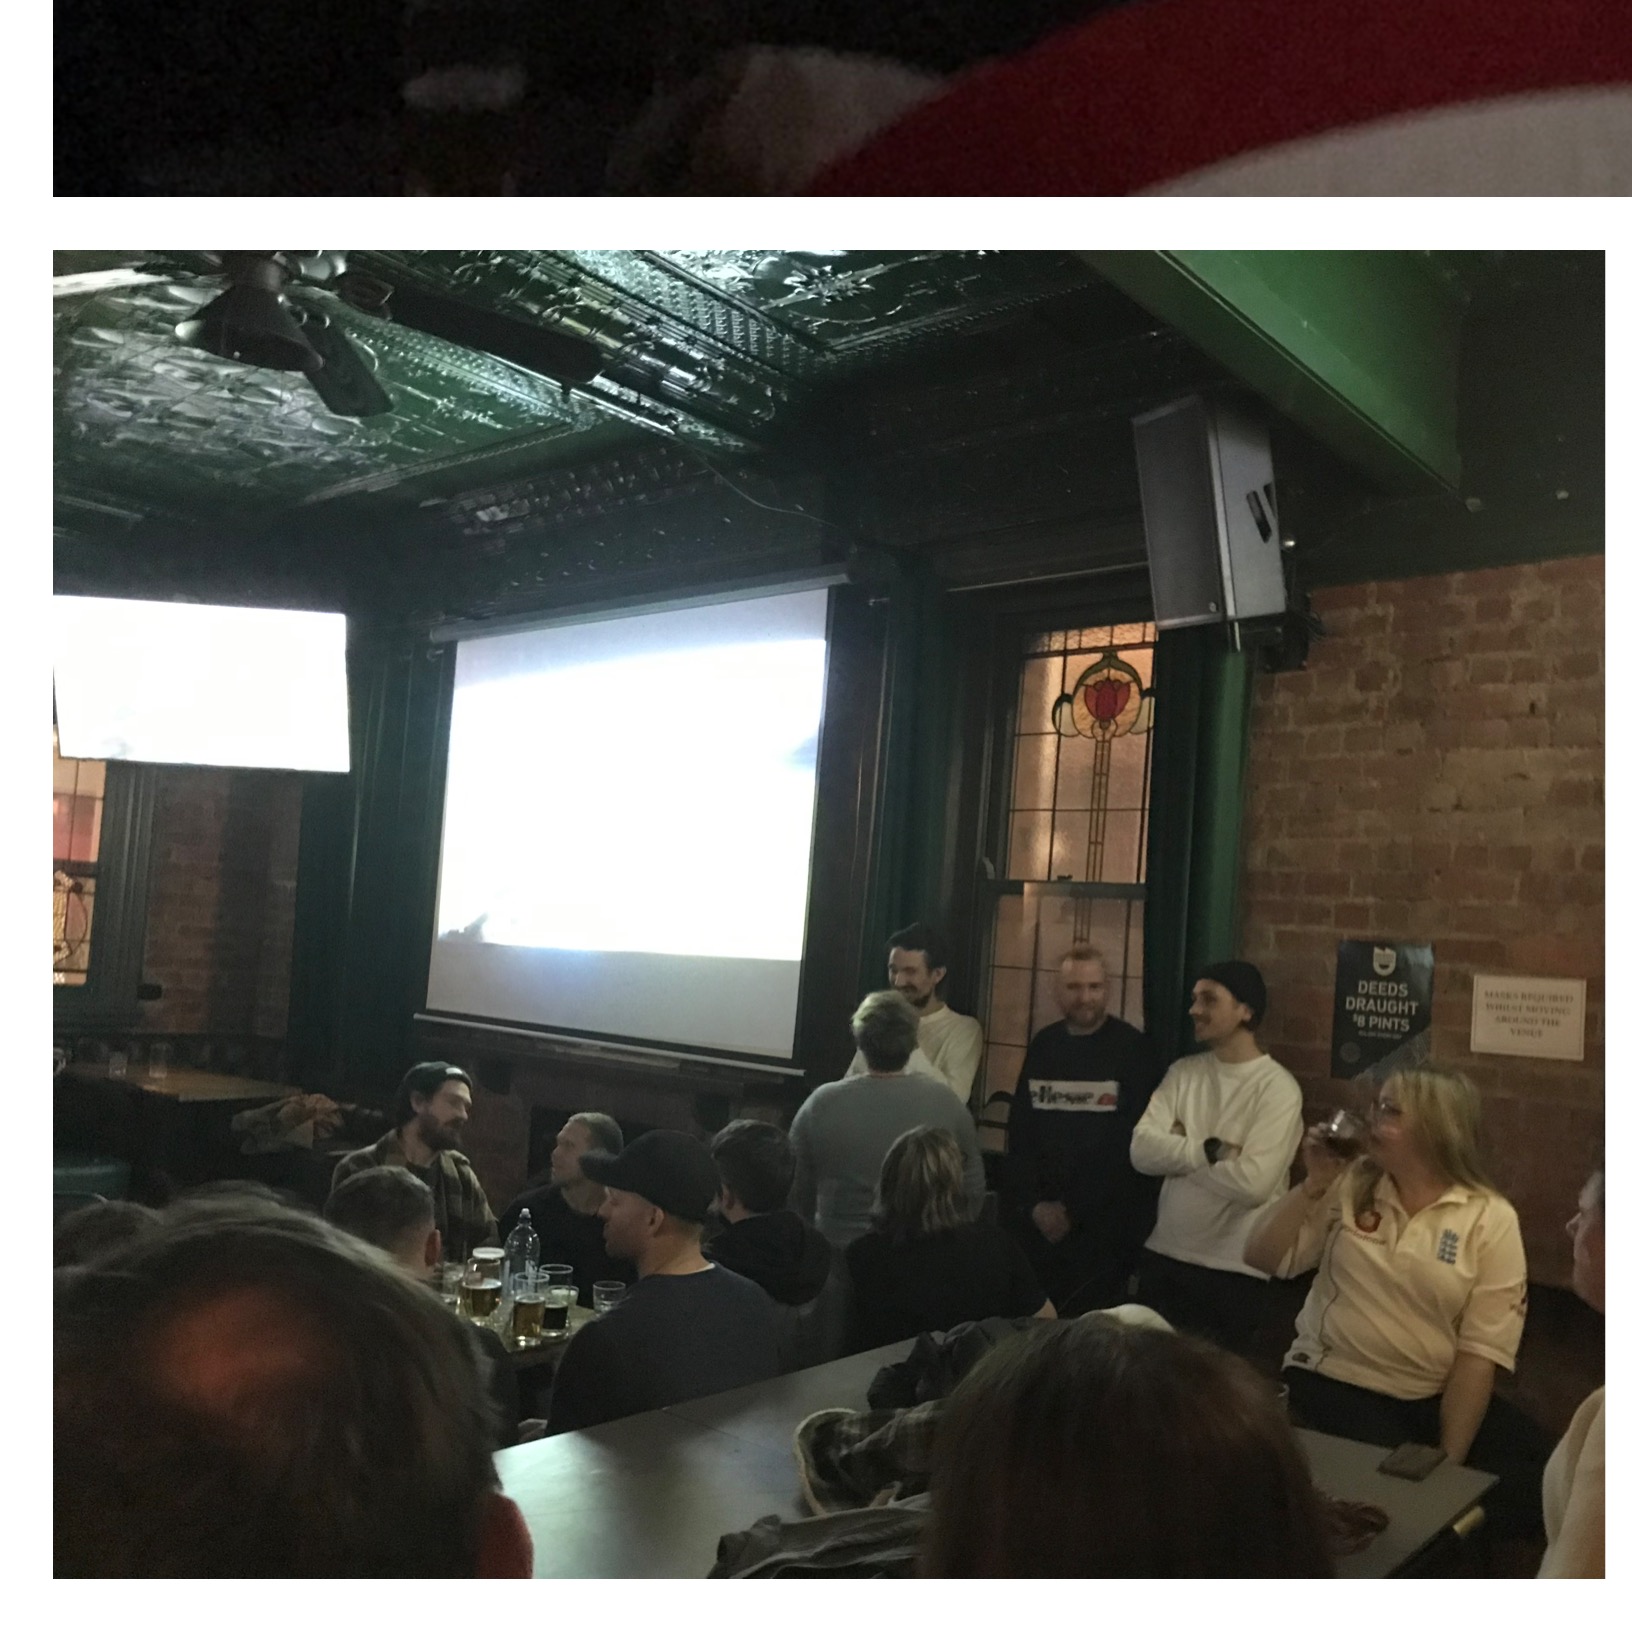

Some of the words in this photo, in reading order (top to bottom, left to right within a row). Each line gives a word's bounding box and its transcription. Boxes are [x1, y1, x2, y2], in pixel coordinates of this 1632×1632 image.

[1358, 980, 1409, 998] DEEDS
[1345, 996, 1419, 1016] DRAUGHT
[1526, 1005, 1571, 1016] MOVING
[1353, 1013, 1366, 1028] $8
[1369, 1015, 1410, 1032] PINTS
[1542, 1017, 1561, 1028] THE
[1510, 1027, 1544, 1039] VENUE
